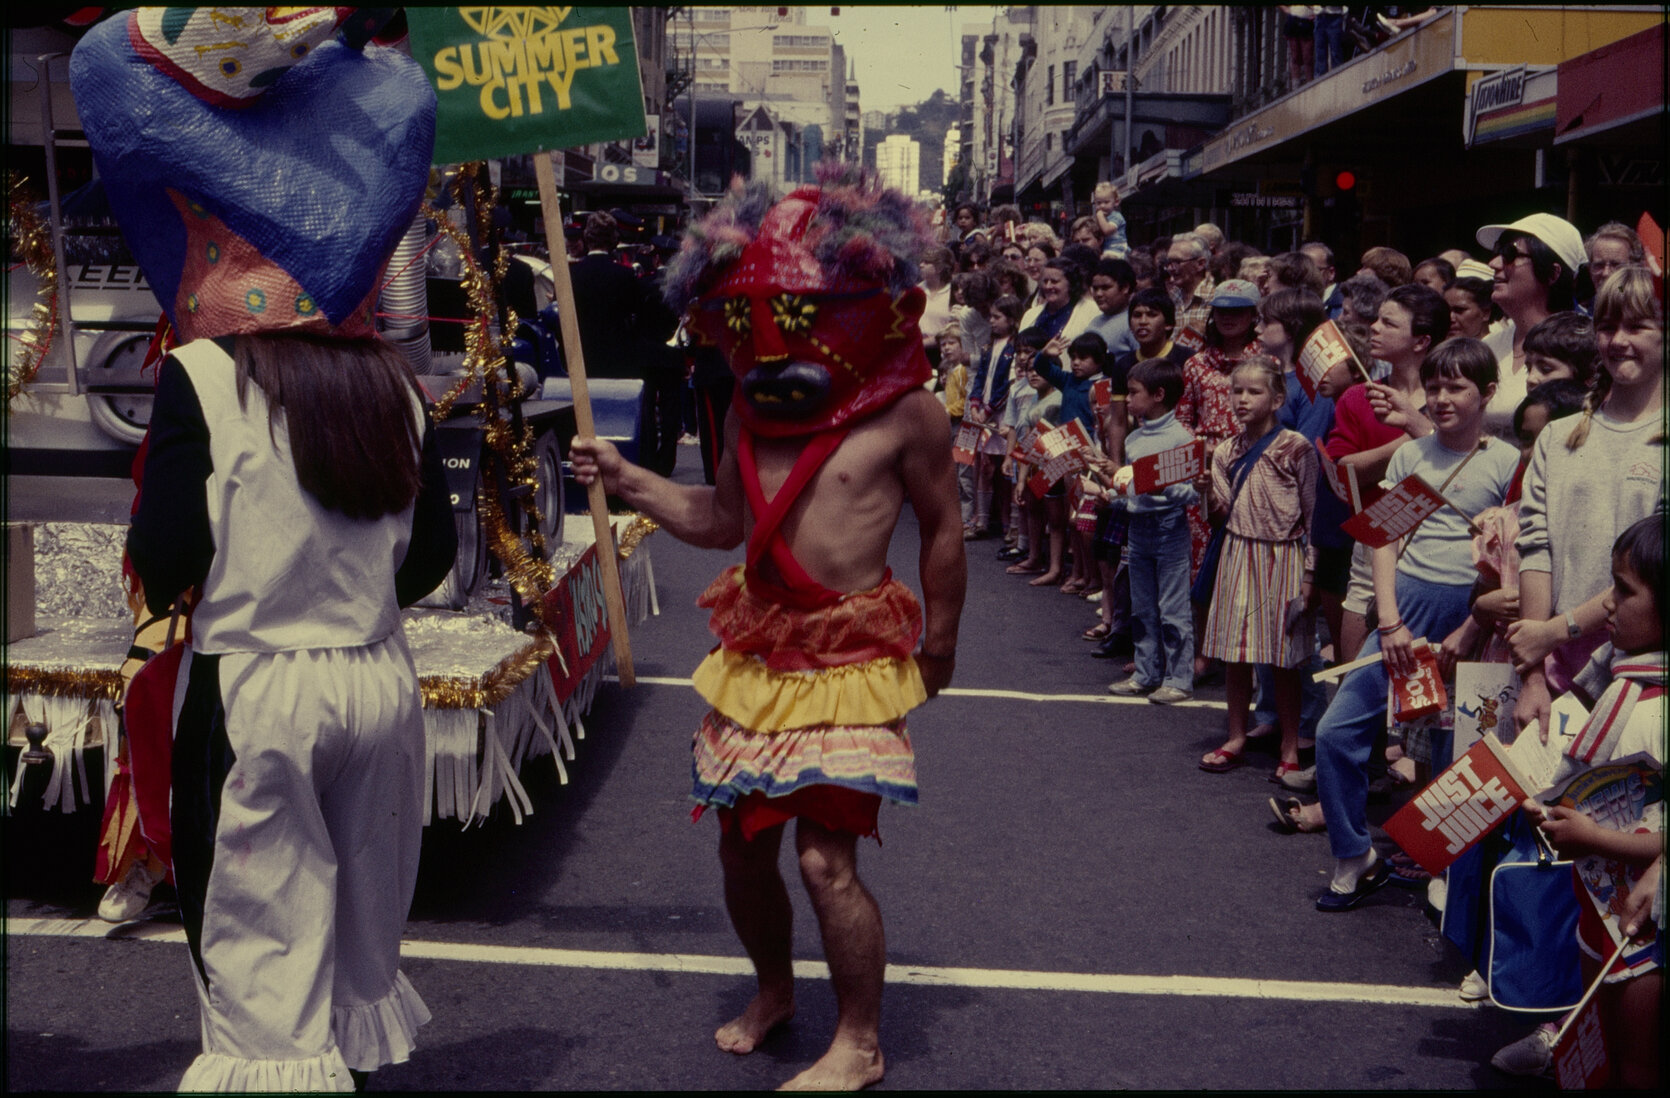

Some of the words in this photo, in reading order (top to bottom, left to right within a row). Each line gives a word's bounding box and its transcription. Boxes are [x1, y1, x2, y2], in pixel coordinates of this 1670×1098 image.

[434, 24, 620, 90] SUMMER
[479, 67, 576, 120] CITY
[1300, 328, 1329, 377] JUST
[1311, 340, 1348, 391] JUICE
[1153, 444, 1196, 470] JUST
[1154, 457, 1200, 486] JUICE
[1364, 483, 1414, 529] JUST
[1380, 493, 1439, 541] JUICE
[1413, 754, 1483, 831] JUST
[1437, 776, 1518, 855] JUICE
